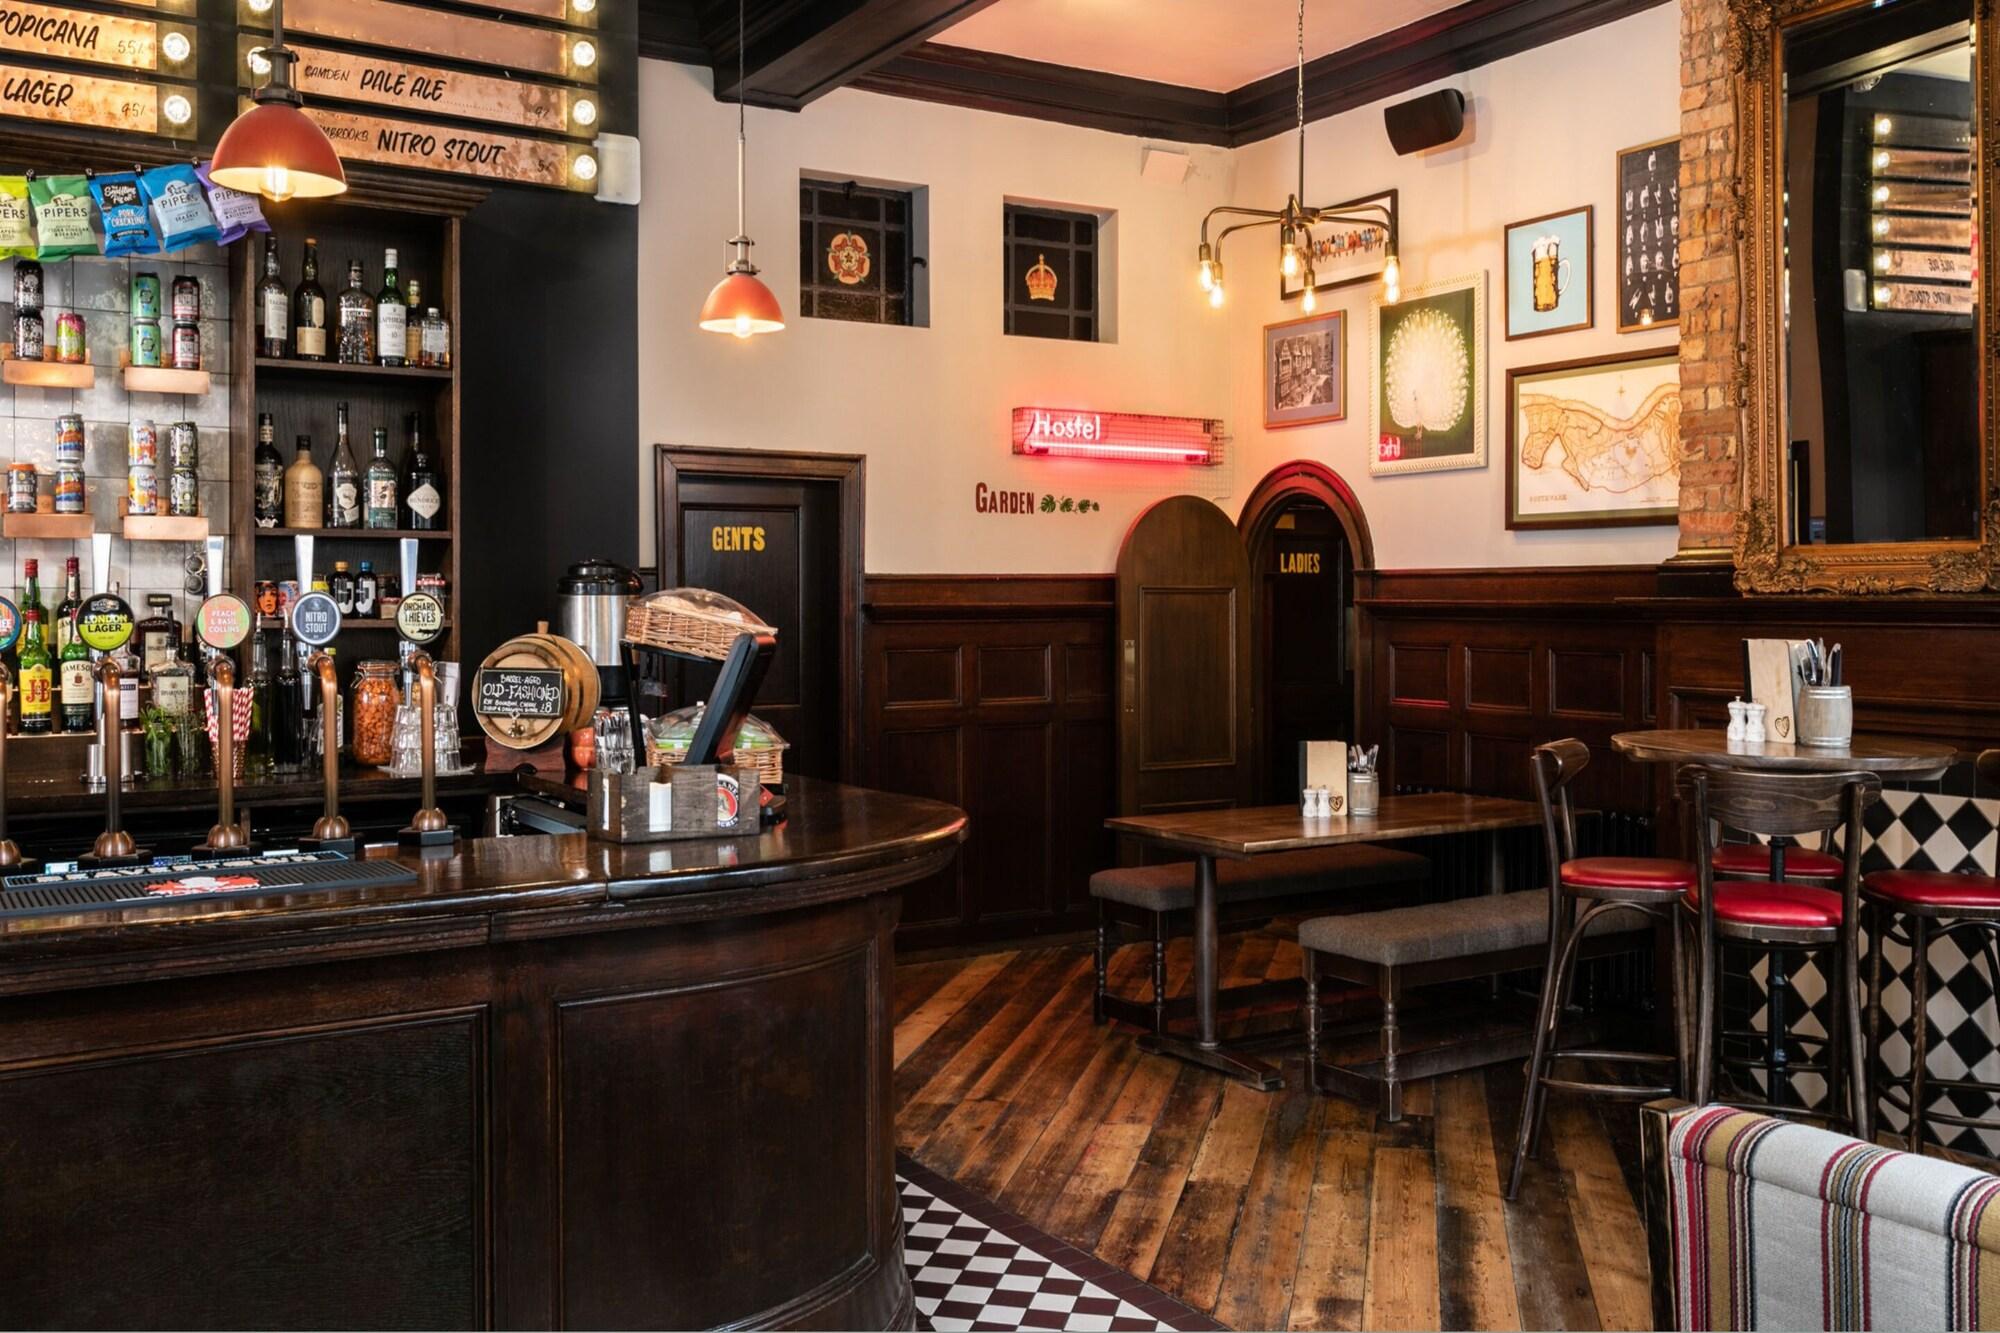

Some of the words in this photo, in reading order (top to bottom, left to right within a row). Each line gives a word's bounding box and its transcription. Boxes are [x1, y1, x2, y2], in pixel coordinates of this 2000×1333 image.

[304, 65, 350, 82] CAMDEN
[360, 69, 406, 95] PALE
[409, 77, 446, 101] ALE
[4, 77, 74, 107] LAGER
[377, 129, 436, 156] NITRO
[443, 138, 506, 164] STOUT
[0, 208, 26, 219] ERS
[43, 207, 88, 218] PIPERS
[1034, 412, 1100, 440] Hostel
[712, 526, 766, 552] GENTS
[1280, 553, 1320, 573] LADIES
[403, 602, 436, 611] ORCHARD
[84, 614, 128, 624] LONDON
[305, 611, 328, 622] NITRO
[404, 611, 436, 623] THIEVES
[305, 623, 327, 633] STOUT
[62, 663, 91, 673] JAMESO
[483, 682, 560, 702] OLD-FASHIONED
